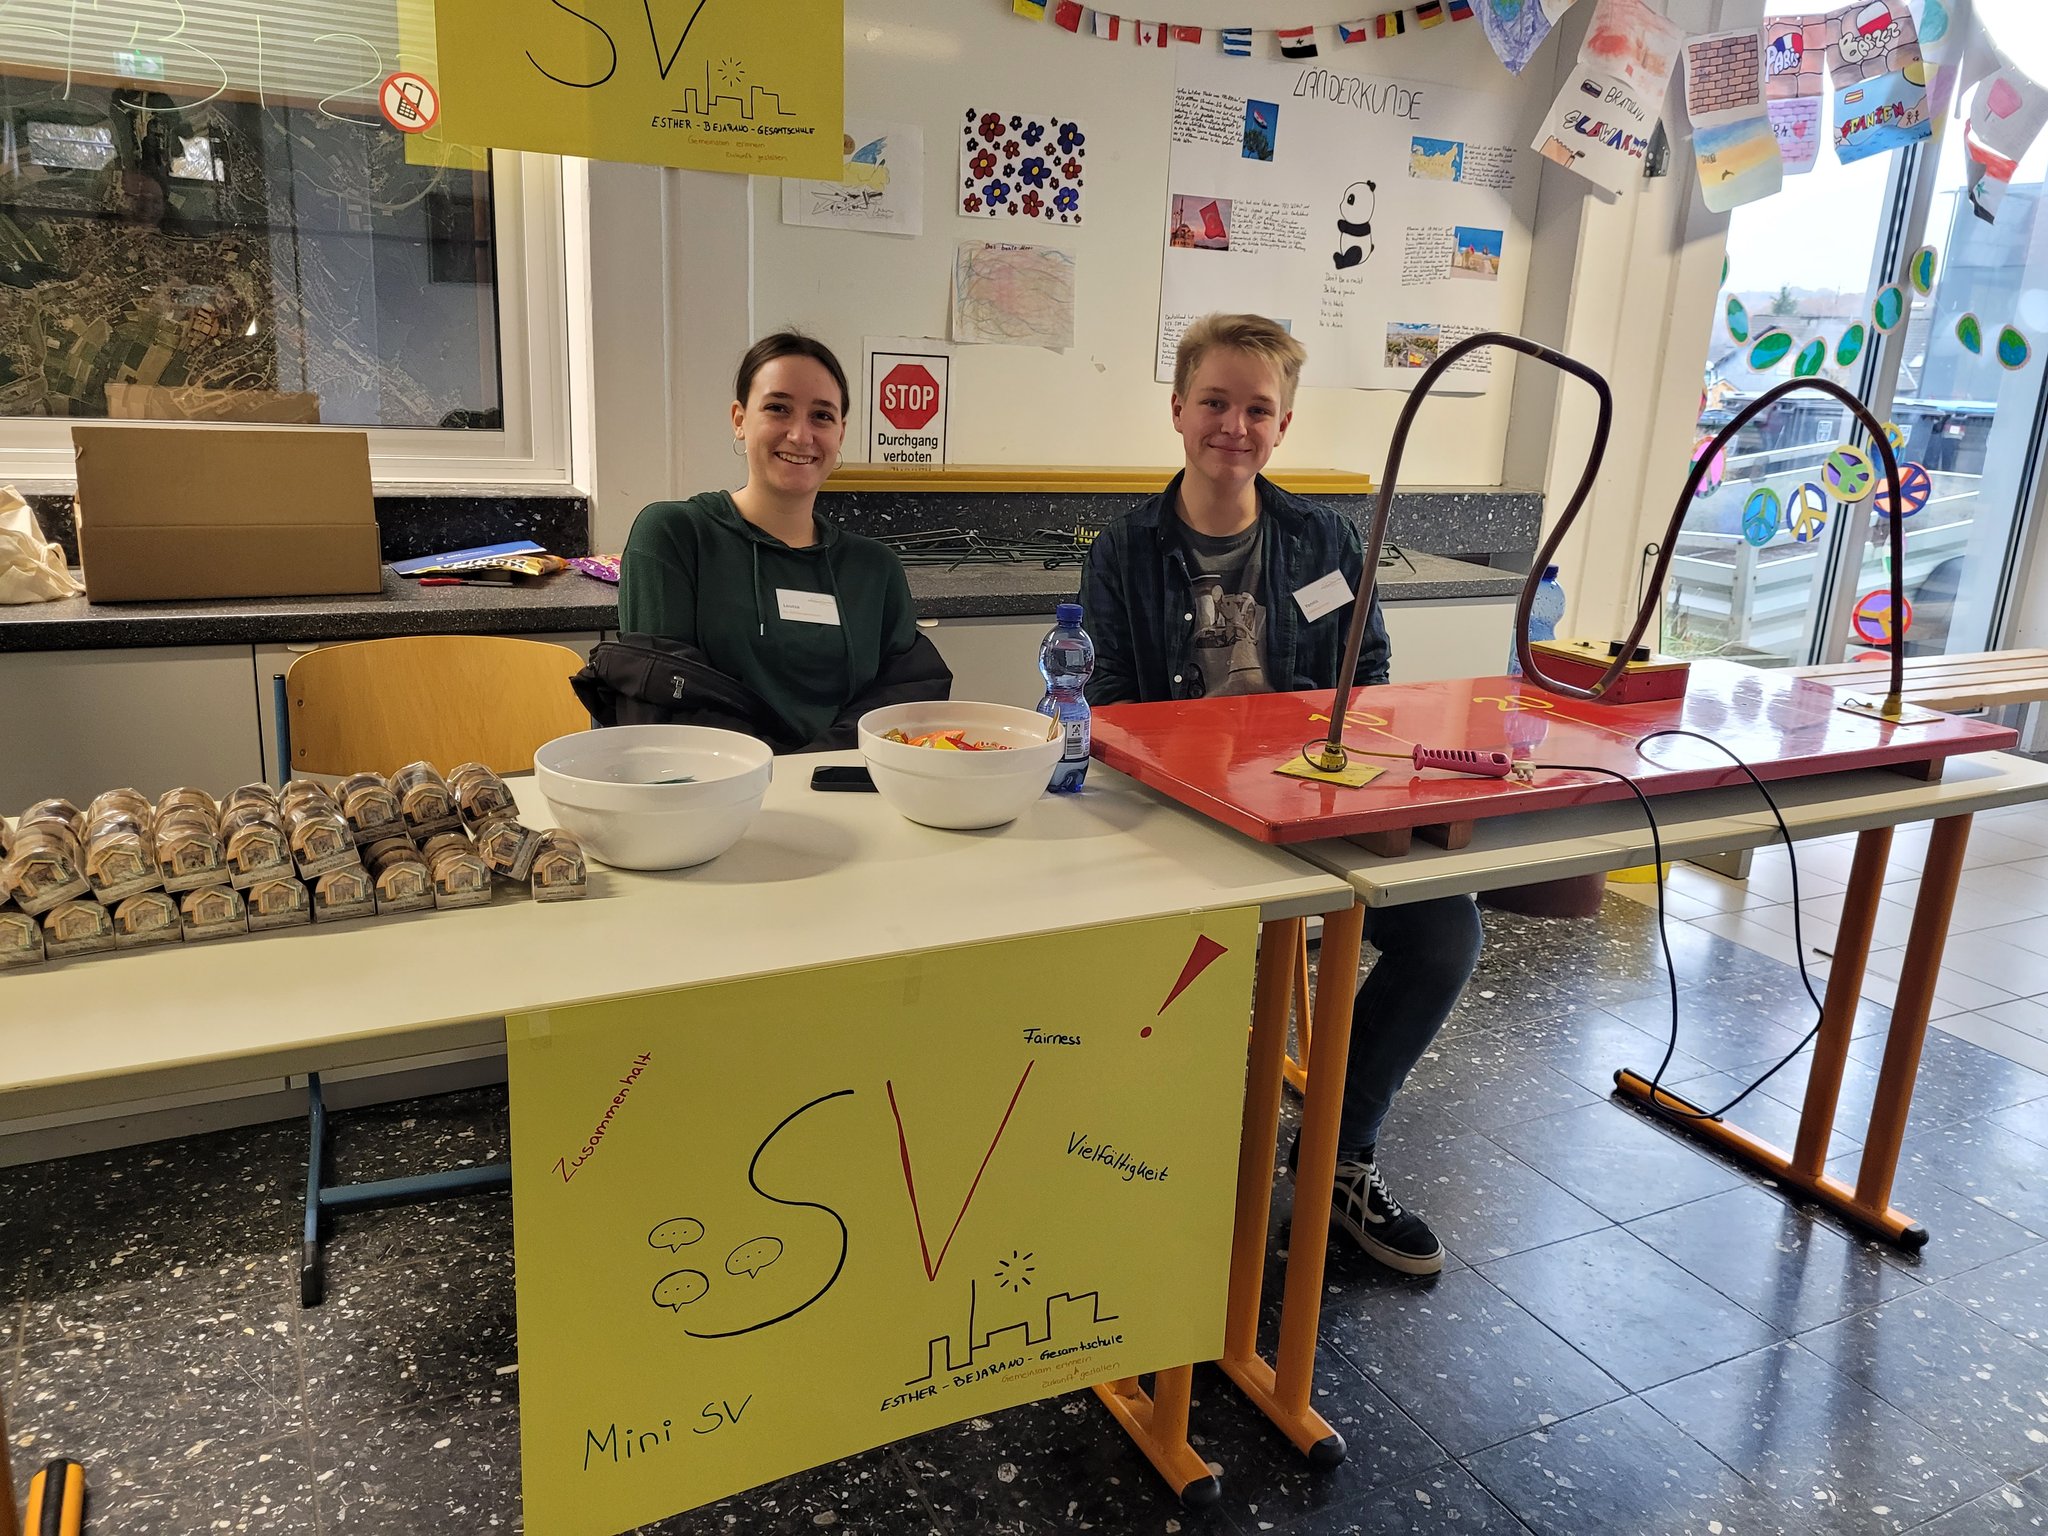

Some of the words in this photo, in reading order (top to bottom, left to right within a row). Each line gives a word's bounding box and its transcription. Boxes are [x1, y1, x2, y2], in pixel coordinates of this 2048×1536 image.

[651, 116, 692, 129] ESTHER
[884, 383, 935, 411] STOP
[877, 433, 939, 449] Durchgang
[883, 450, 932, 462] verboten
[1023, 1027, 1082, 1045] Fairness
[551, 1051, 652, 1183] Zusammenhalt
[1066, 1131, 1169, 1182] Vielfältigkeit
[880, 1385, 938, 1412] ESTHER
[953, 1357, 1024, 1388] BEJARANO
[1039, 1333, 1124, 1361] Gesamtschule
[584, 1419, 673, 1472] Mini
[692, 1394, 753, 1435] SV
